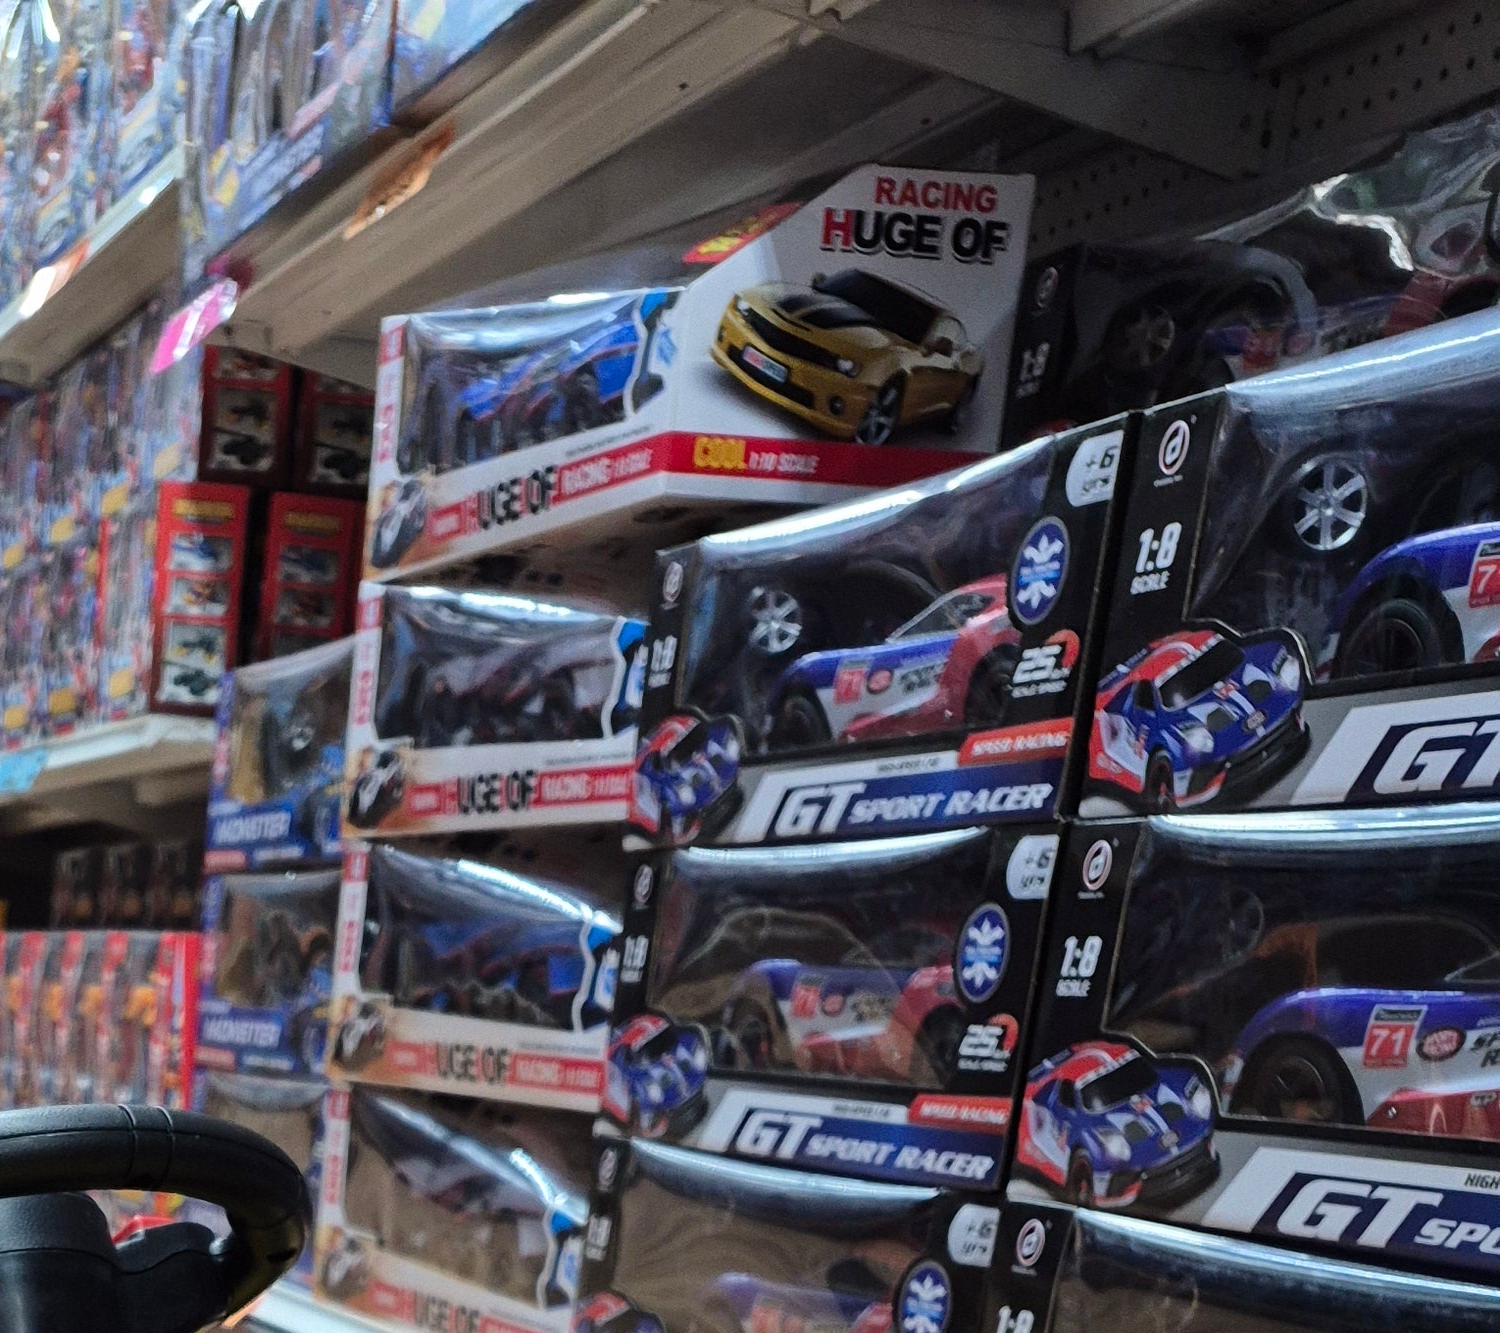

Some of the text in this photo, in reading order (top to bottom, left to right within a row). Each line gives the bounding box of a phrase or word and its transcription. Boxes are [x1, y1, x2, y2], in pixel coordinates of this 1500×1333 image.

[874, 175, 998, 213] RACING
[820, 207, 1011, 265] HUGE OF
[1136, 522, 1182, 573] 1:8
[1477, 564, 1500, 594] 7
[775, 781, 1054, 837] GT SPORT RACER
[1061, 936, 1103, 978] 1:8
[1370, 1028, 1406, 1057] 71
[737, 1111, 995, 1180] GT SPORT RACER
[1276, 1178, 1444, 1249] GT
